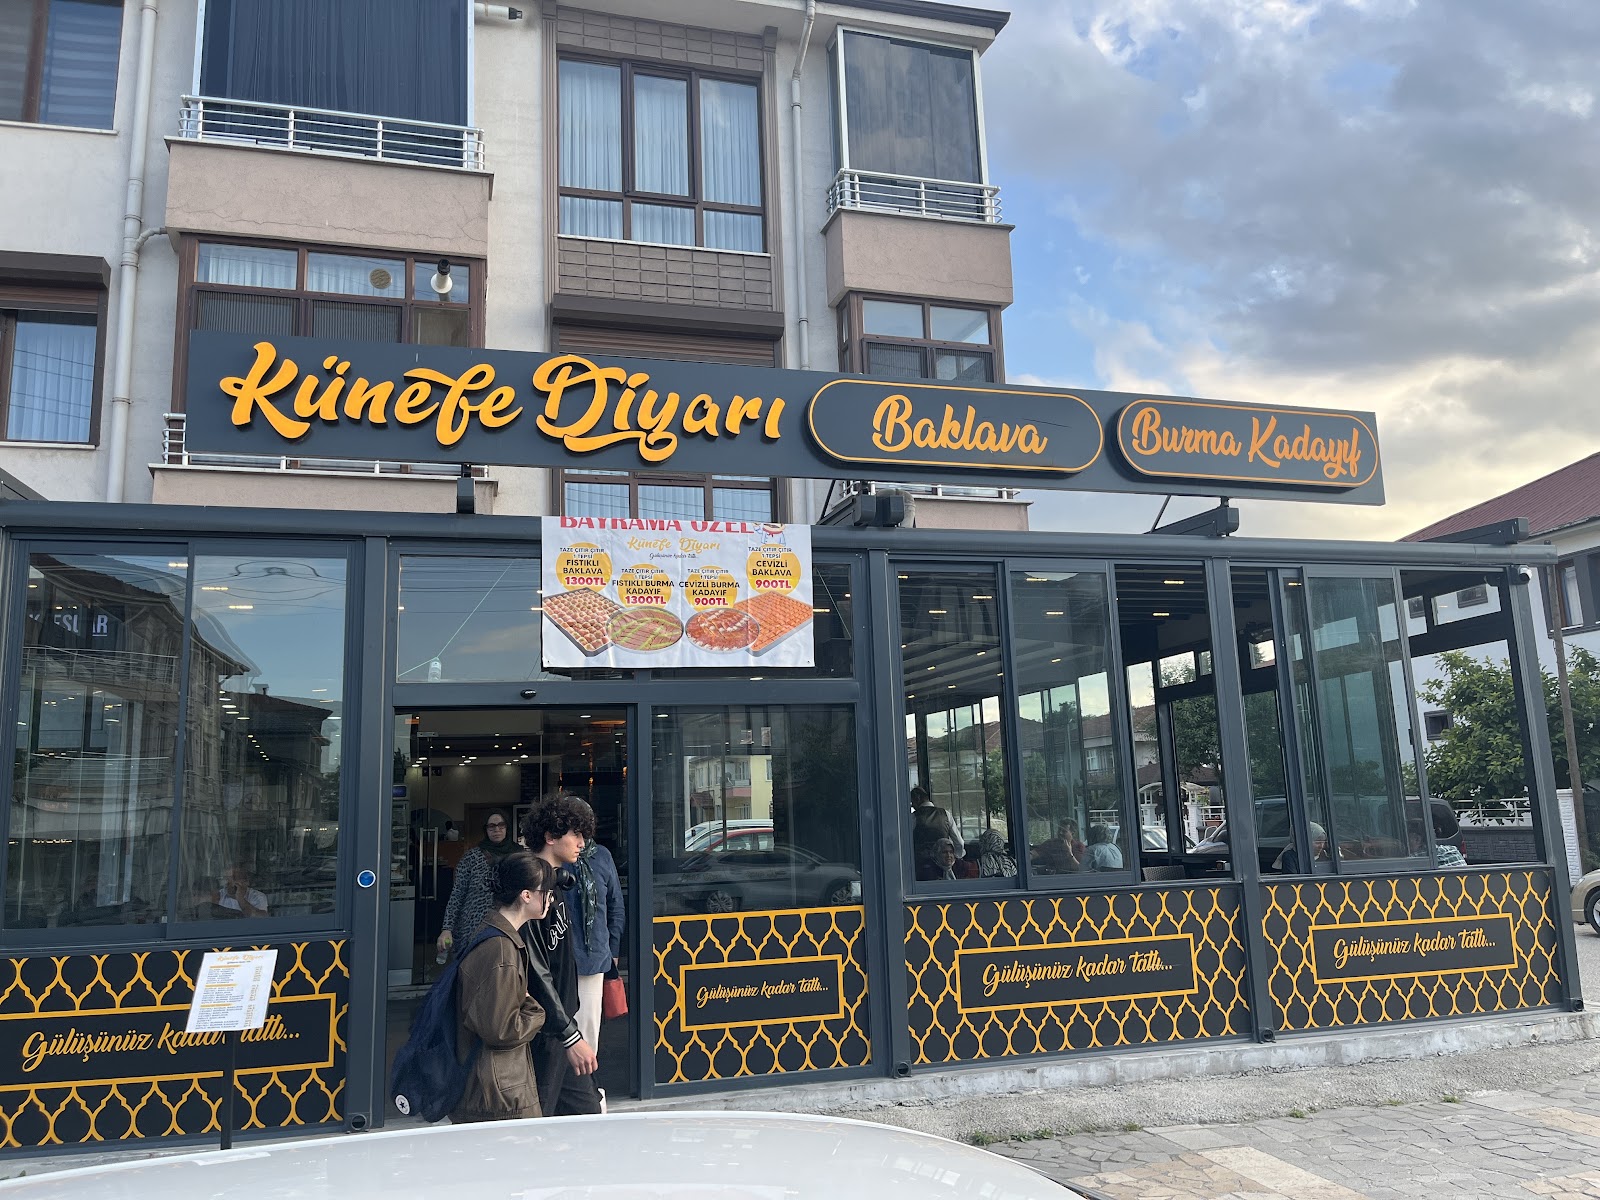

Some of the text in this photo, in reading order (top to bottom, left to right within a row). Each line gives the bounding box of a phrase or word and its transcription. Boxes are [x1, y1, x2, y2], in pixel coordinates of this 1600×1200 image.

[219, 341, 785, 463] Künefe Diyarı
[872, 394, 1048, 454] Baklava
[1131, 406, 1361, 479] Burma Kadayıf
[627, 536, 720, 554] Künefe Diyarı
[756, 559, 788, 568] CEVİZLİ
[563, 567, 603, 575] BAKLAVA
[752, 568, 792, 577] BAKLAVA
[565, 576, 607, 586] 1300TL
[612, 579, 643, 587] FISTIKLI
[678, 580, 740, 589] CEVİZLİ BURMA
[755, 579, 792, 589] 900TL
[626, 587, 662, 595] KADAYIF
[692, 589, 727, 597] KADAYIF
[625, 595, 667, 605] 1300TL
[694, 597, 729, 607] 900TL
[1333, 936, 1412, 970] Gülüşünüz
[1413, 931, 1456, 957] kadar
[982, 960, 1073, 997] Gülüşünüz
[1075, 953, 1126, 982] kadar
[696, 984, 759, 1009] Gülüşünüz
[760, 979, 797, 999] kadar
[22, 1028, 154, 1072] Gülüşünüz
